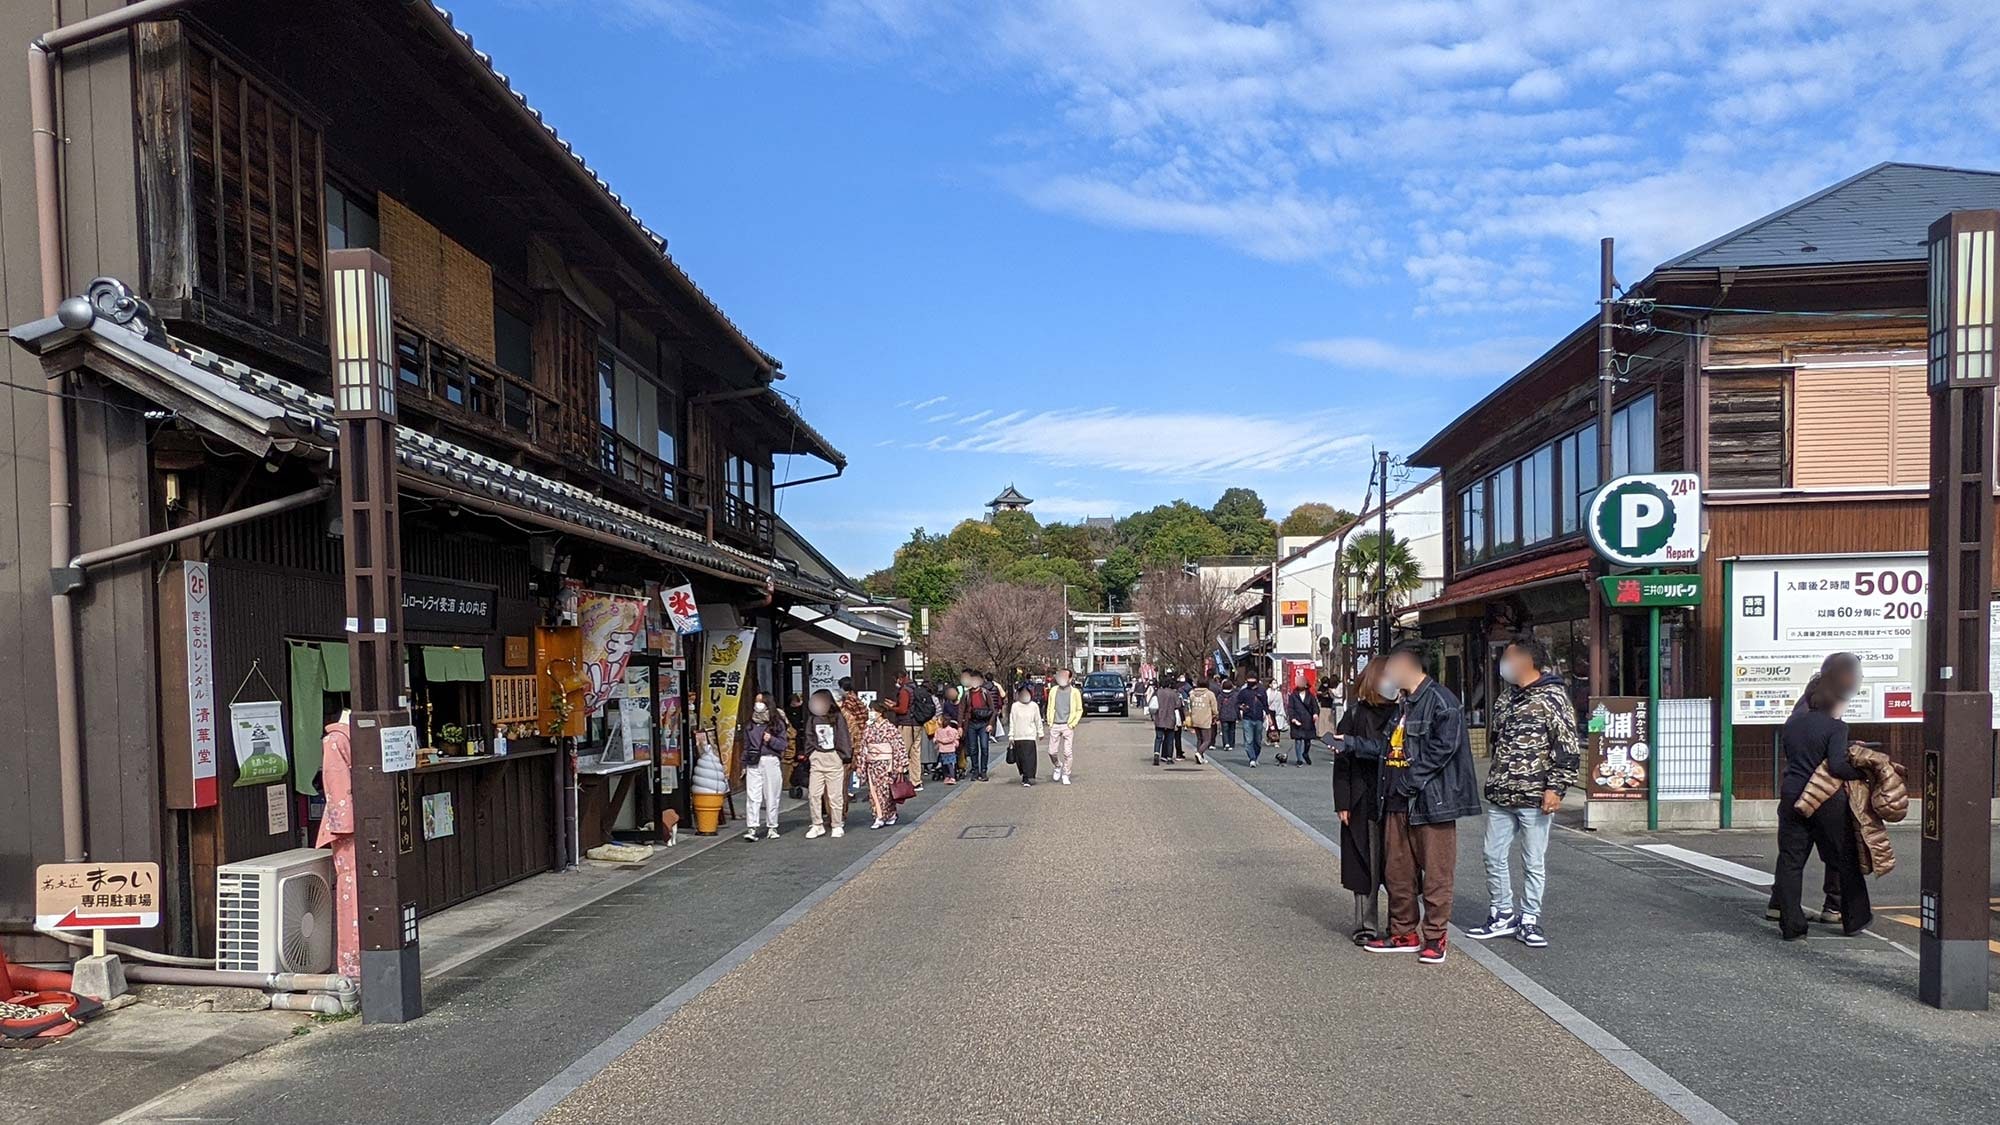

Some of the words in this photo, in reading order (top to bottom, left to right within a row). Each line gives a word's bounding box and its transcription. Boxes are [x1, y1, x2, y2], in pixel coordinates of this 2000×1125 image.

[1671, 479, 1696, 496] 24h
[1620, 493, 1665, 548] P
[1666, 546, 1695, 560] Repark
[192, 575, 204, 594] 2F
[1643, 584, 1697, 598] 三井のリパーク
[1787, 579, 1850, 592] 入庫後2時間
[458, 599, 488, 616] 丸の内店
[669, 591, 696, 618] 氷
[1817, 607, 1881, 619] 以降60分毎に
[192, 610, 205, 700] きものレンタル
[1749, 666, 1791, 676] 三井のリパーク
[196, 707, 212, 765] 清華堂
[86, 867, 153, 893] まつい
[81, 893, 152, 908] 専用駐車場
